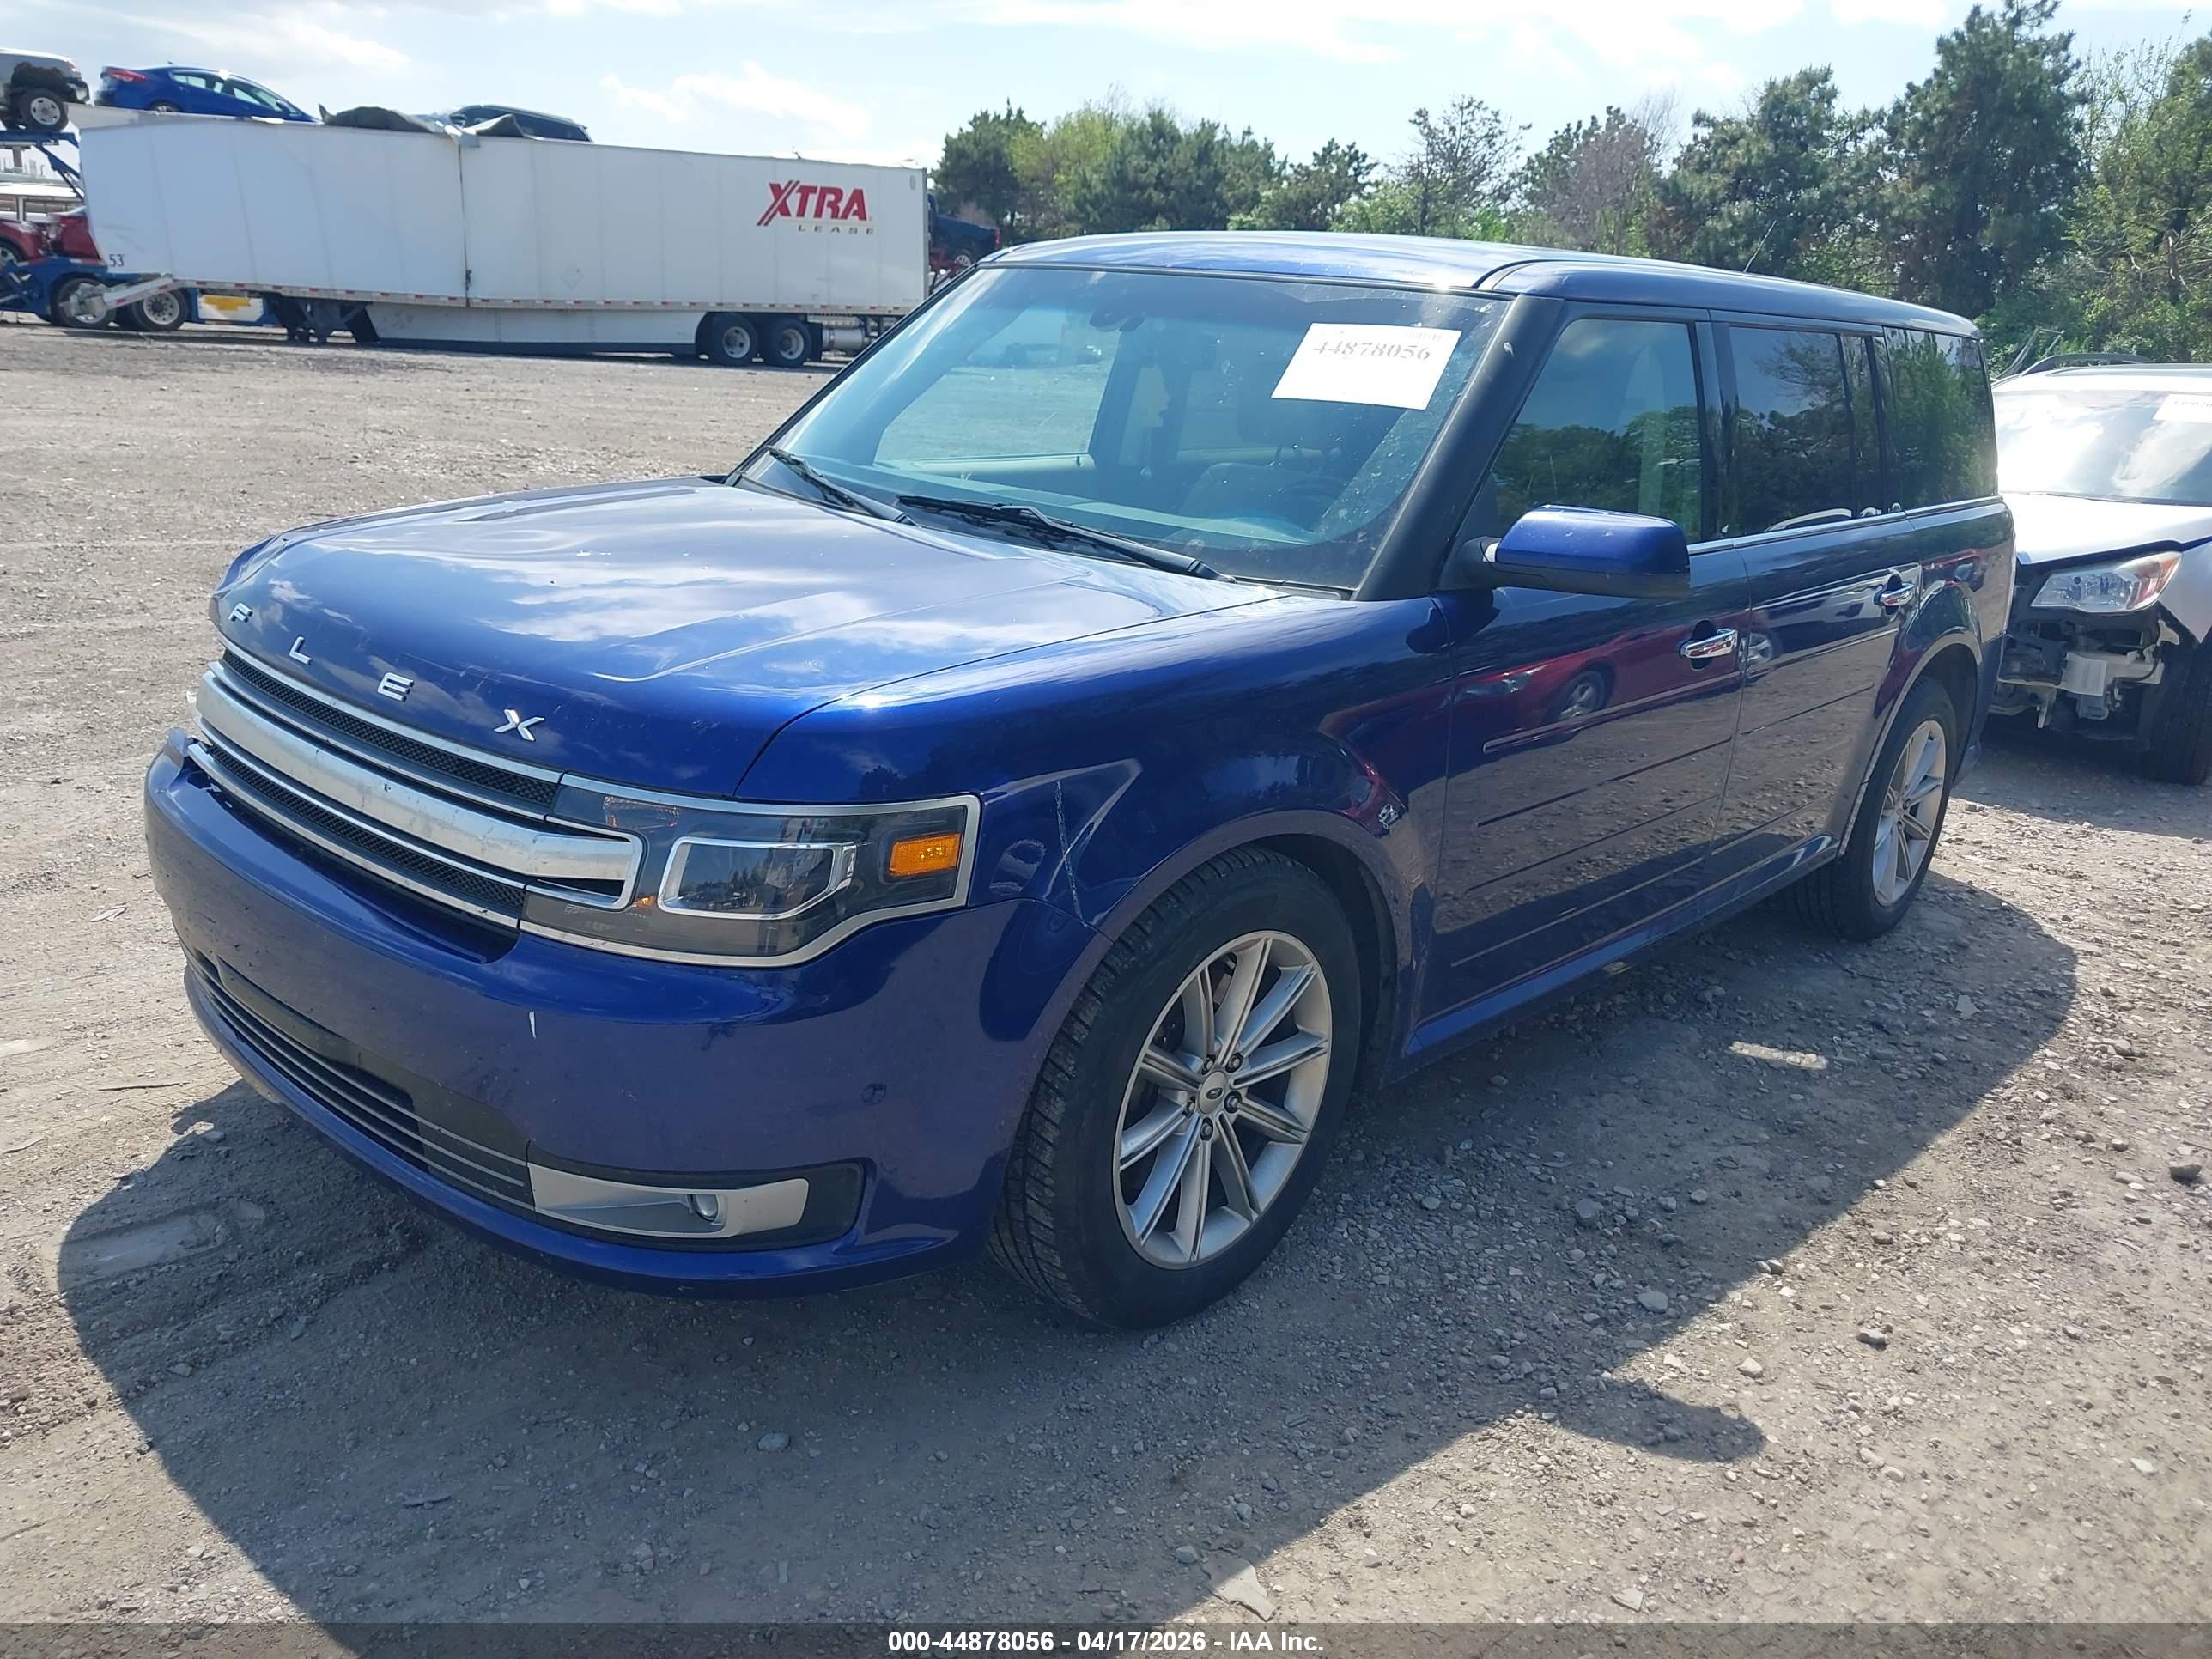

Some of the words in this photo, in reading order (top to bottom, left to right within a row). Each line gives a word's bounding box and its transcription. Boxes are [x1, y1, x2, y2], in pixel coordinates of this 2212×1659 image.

[757, 179, 868, 227] XTRA
[798, 224, 874, 235] LEASE
[1313, 340, 1431, 362] 44878056
[228, 602, 546, 742] FLEX
